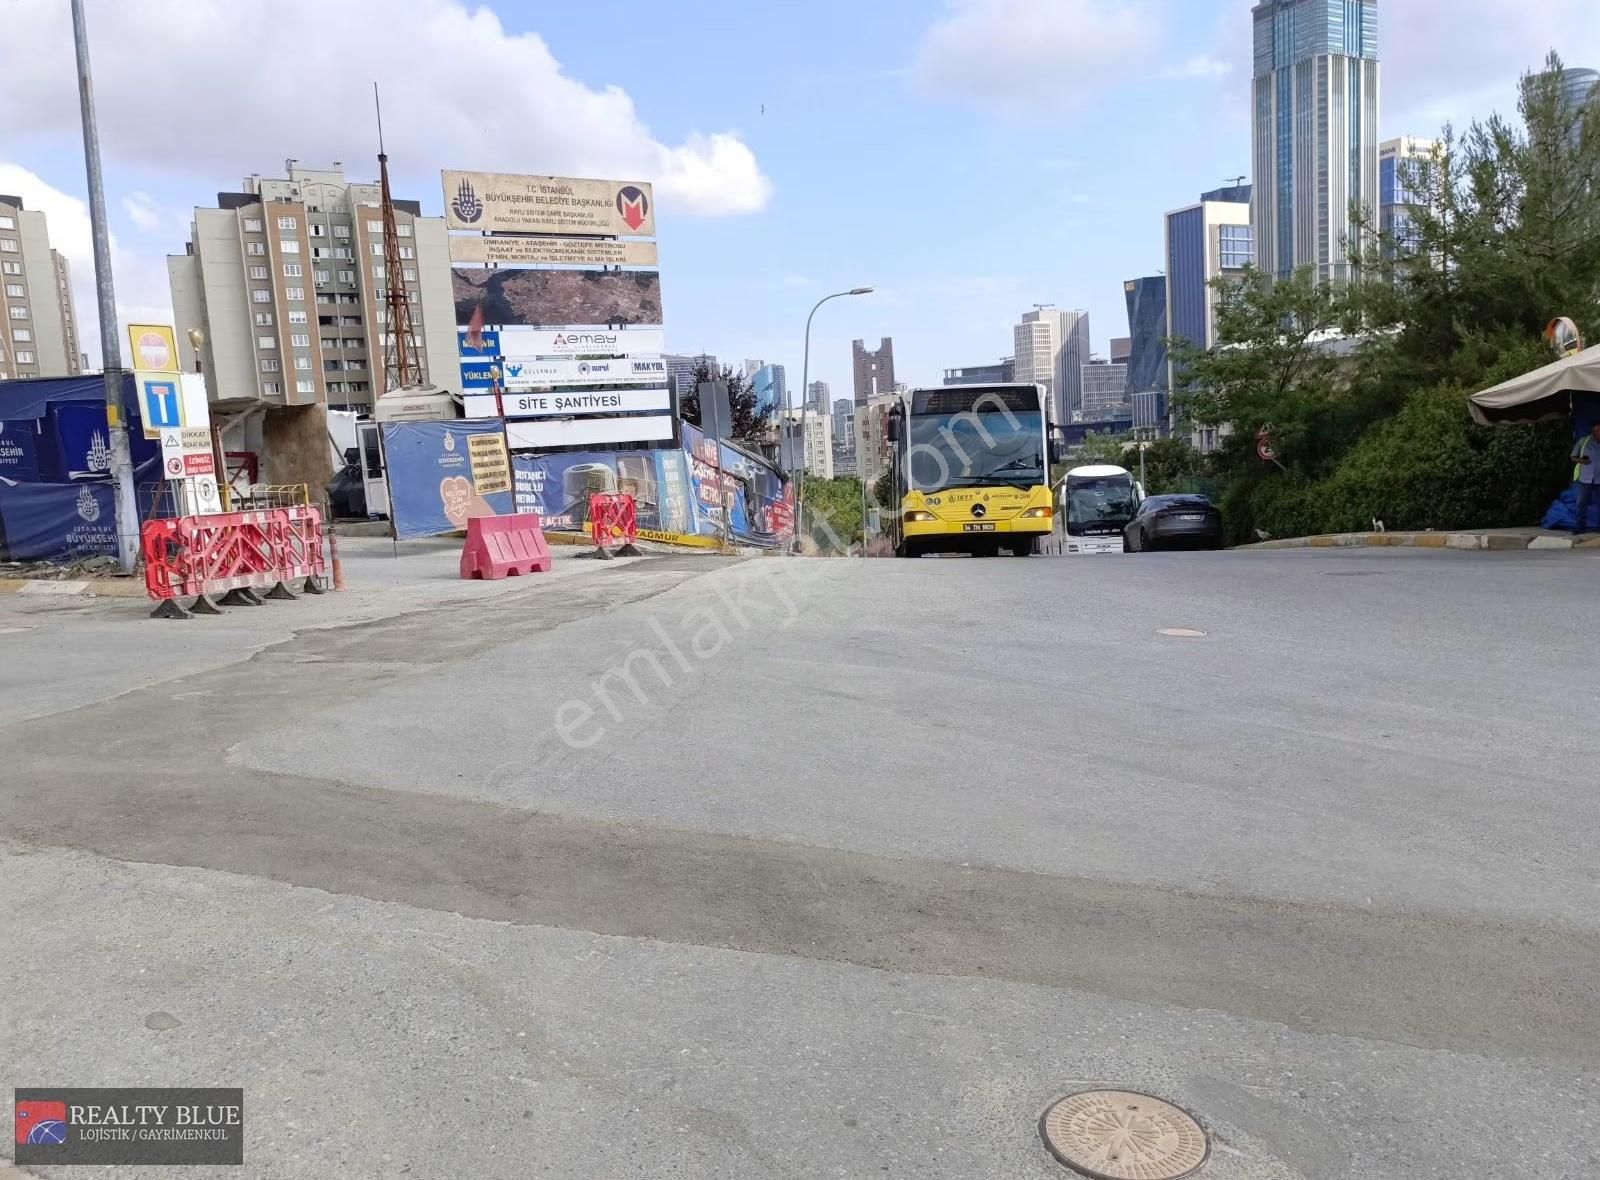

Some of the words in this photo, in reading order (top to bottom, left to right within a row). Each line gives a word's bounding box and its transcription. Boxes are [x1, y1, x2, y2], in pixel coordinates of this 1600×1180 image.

[485, 193, 534, 204] BÜYÜKŞEHİR
[535, 196, 570, 206] BELEDİYE
[566, 333, 617, 344] emay
[633, 362, 665, 371] MAKYOL
[519, 397, 548, 410] SİTE
[554, 395, 621, 411] ŞANTİYESİ
